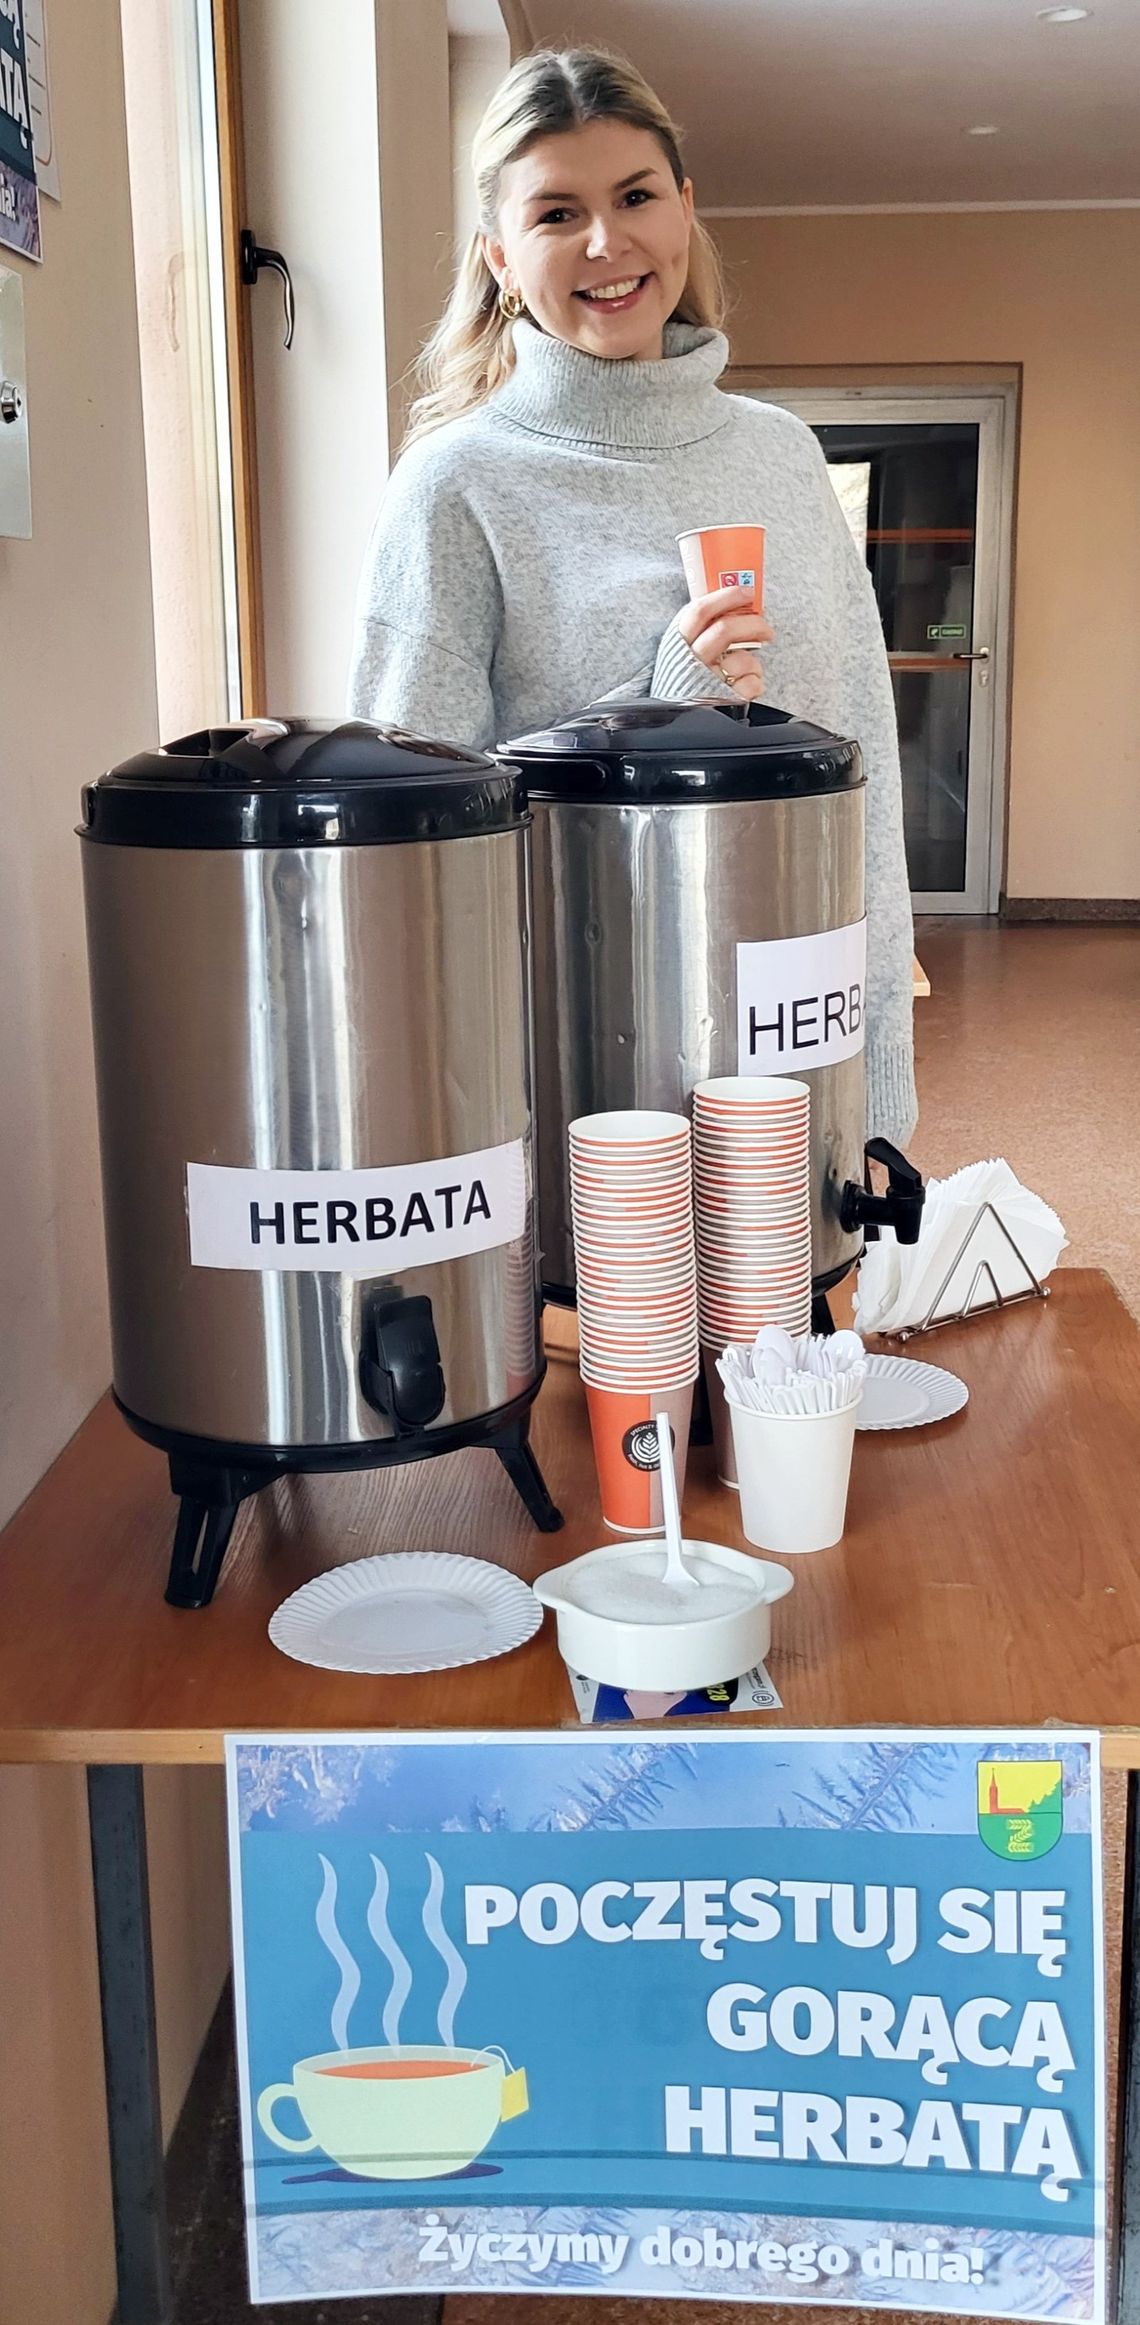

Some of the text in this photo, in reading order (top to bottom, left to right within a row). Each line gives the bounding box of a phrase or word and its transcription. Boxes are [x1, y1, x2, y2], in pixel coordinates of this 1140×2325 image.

[749, 983, 865, 1056] HERB
[249, 1179, 492, 1244] HERBATA
[631, 1424, 654, 1436] SPECIALTY
[463, 1877, 1068, 1978] POCZĘSTUJ SIĘ
[706, 1982, 1077, 2094] GORĄCĄ
[664, 2084, 1085, 2203] HERBATĄ
[418, 2213, 986, 2286] Życzymy dobrego dnia!
